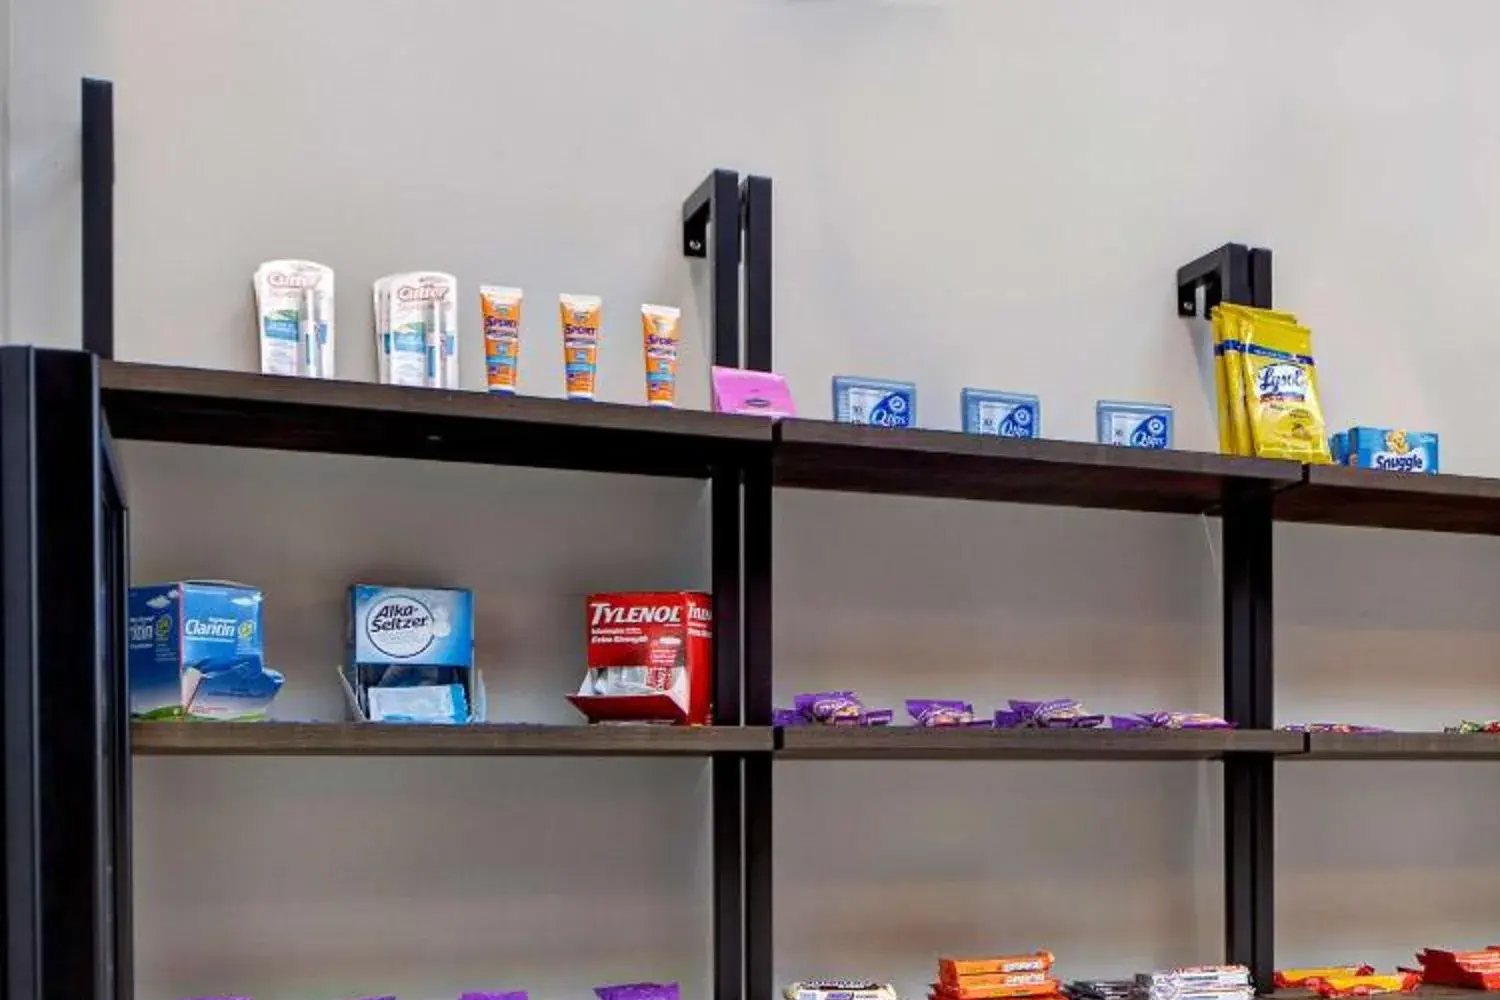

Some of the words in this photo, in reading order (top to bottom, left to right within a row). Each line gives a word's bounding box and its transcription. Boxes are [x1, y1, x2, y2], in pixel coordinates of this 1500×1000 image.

[1259, 365, 1306, 391] Lysol
[1376, 454, 1423, 471] Snuggle
[375, 604, 419, 618] Alka-
[590, 602, 682, 625] TYLENOL
[185, 619, 235, 637] Claritin
[370, 617, 427, 633] Seltzer
